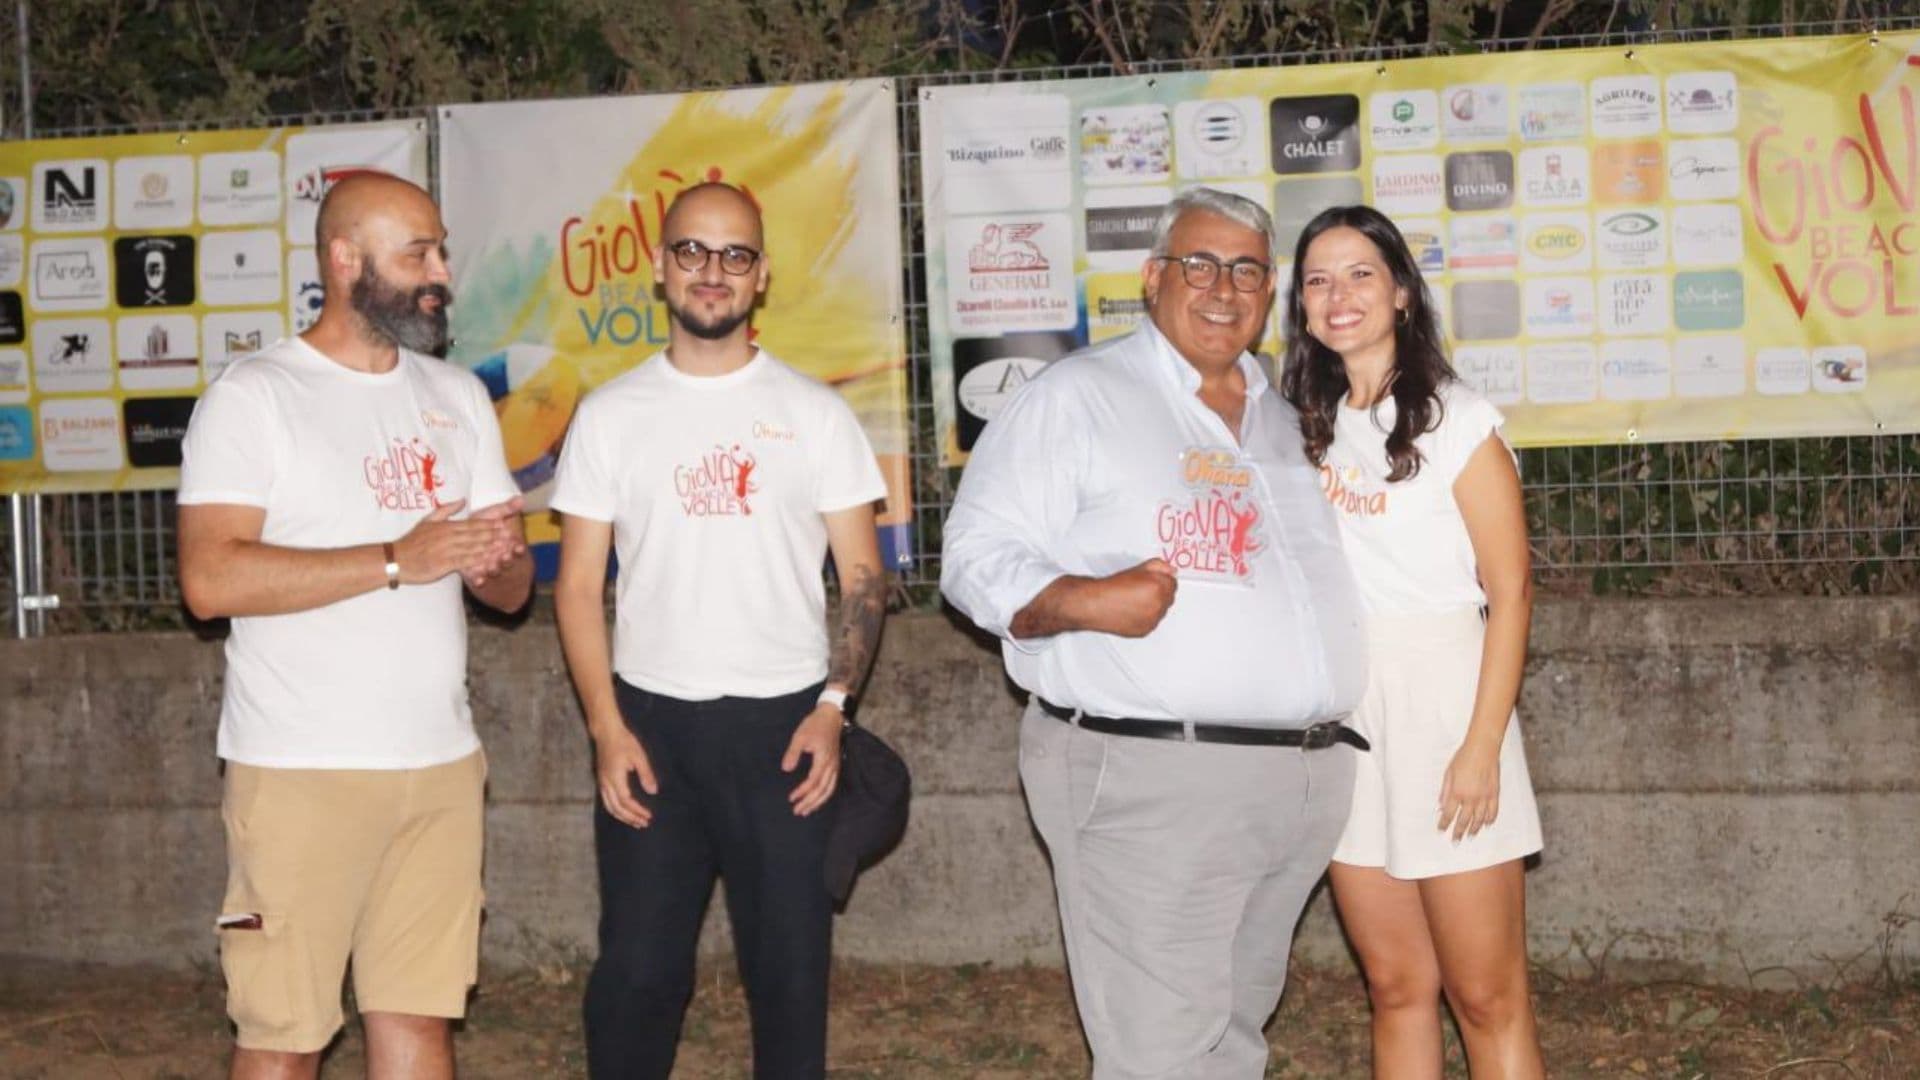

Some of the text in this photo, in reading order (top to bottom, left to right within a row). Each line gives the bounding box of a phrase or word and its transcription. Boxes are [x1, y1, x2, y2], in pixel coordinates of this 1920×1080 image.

[1283, 140, 1345, 158] CHALET
[1453, 182, 1508, 197] DIVINO
[1527, 178, 1582, 194] CASA
[1535, 231, 1579, 250] CMC
[968, 272, 1051, 291] GENERALI
[1162, 546, 1242, 573] VOLLEY
